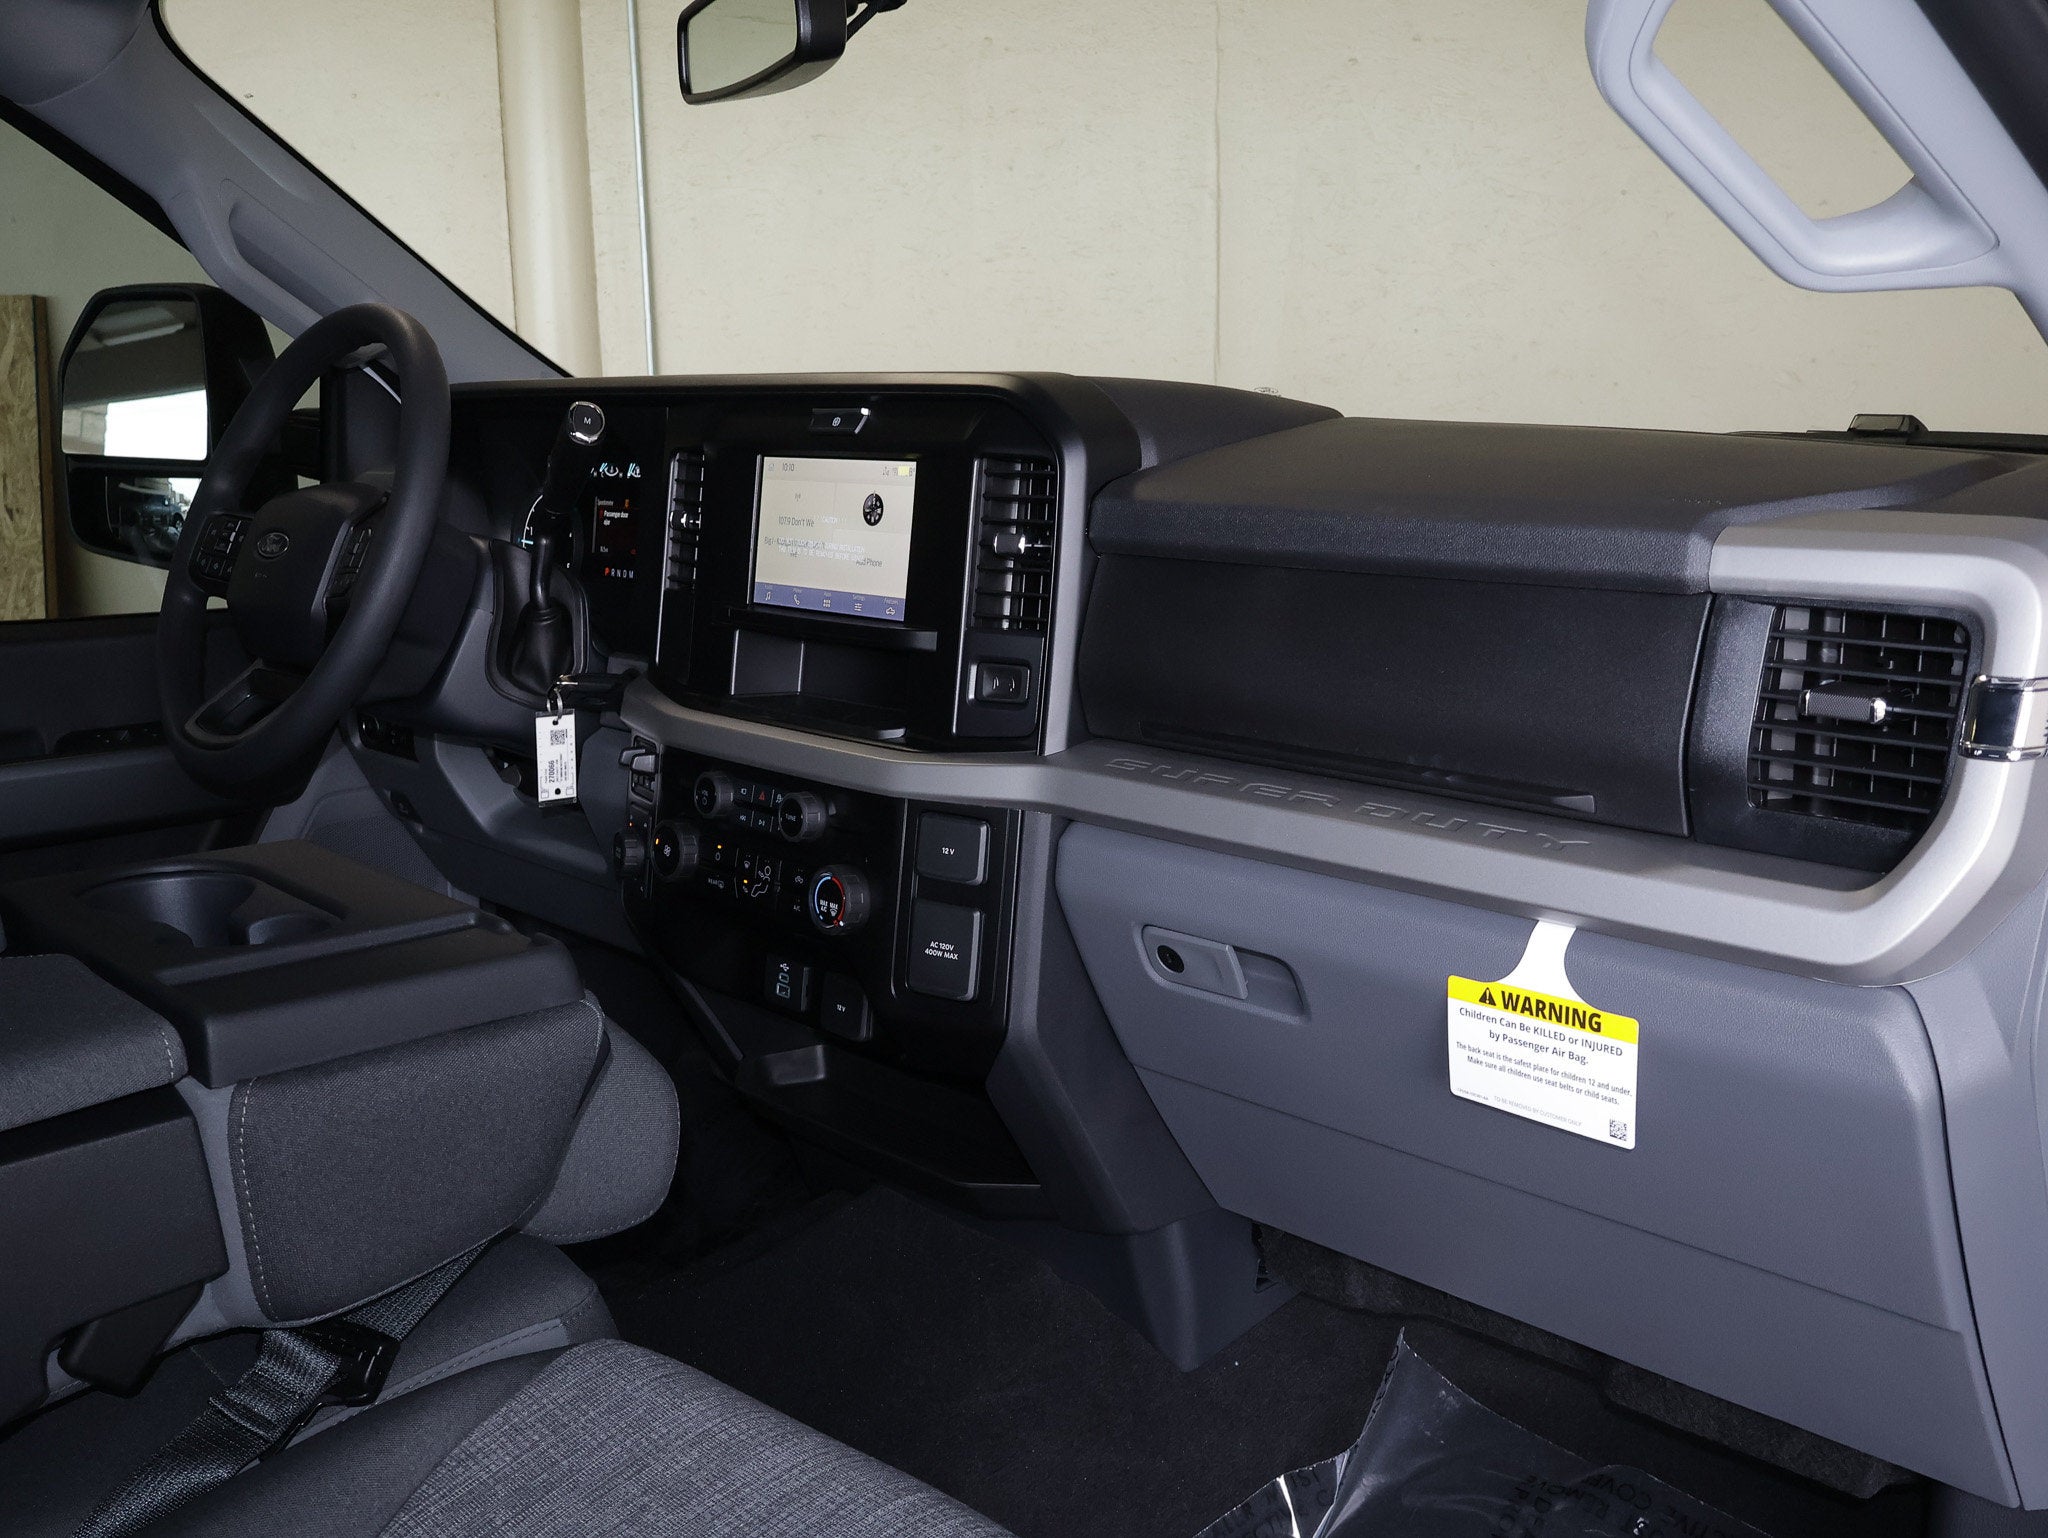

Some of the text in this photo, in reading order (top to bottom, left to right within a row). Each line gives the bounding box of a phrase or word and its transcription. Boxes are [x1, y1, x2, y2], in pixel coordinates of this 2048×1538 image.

[866, 558, 882, 568] Phone
[1105, 758, 1590, 850] SUPER DUTY
[942, 847, 950, 855] 12
[820, 899, 838, 910] MAX MAX
[924, 948, 958, 960] 400W MAX
[930, 941, 954, 952] AC 120V
[1501, 990, 1602, 1033] WARNING
[1460, 1007, 1623, 1056] Children Can Be KILLED or INJURED
[1490, 1030, 1588, 1066] by Passenger Air Bag.
[1456, 1041, 1633, 1097] The back seat is the safest place for children 12 and under.
[1468, 1055, 1483, 1066] Make
[1484, 1061, 1497, 1070] sure
[1508, 1067, 1531, 1080] children
[1533, 1076, 1543, 1084] use
[1544, 1078, 1558, 1088] seat
[1560, 1082, 1574, 1092] belts
[1584, 1090, 1600, 1100] child
[1601, 1094, 1620, 1106] seats.
[1509, 1101, 1532, 1112] REMOVED
